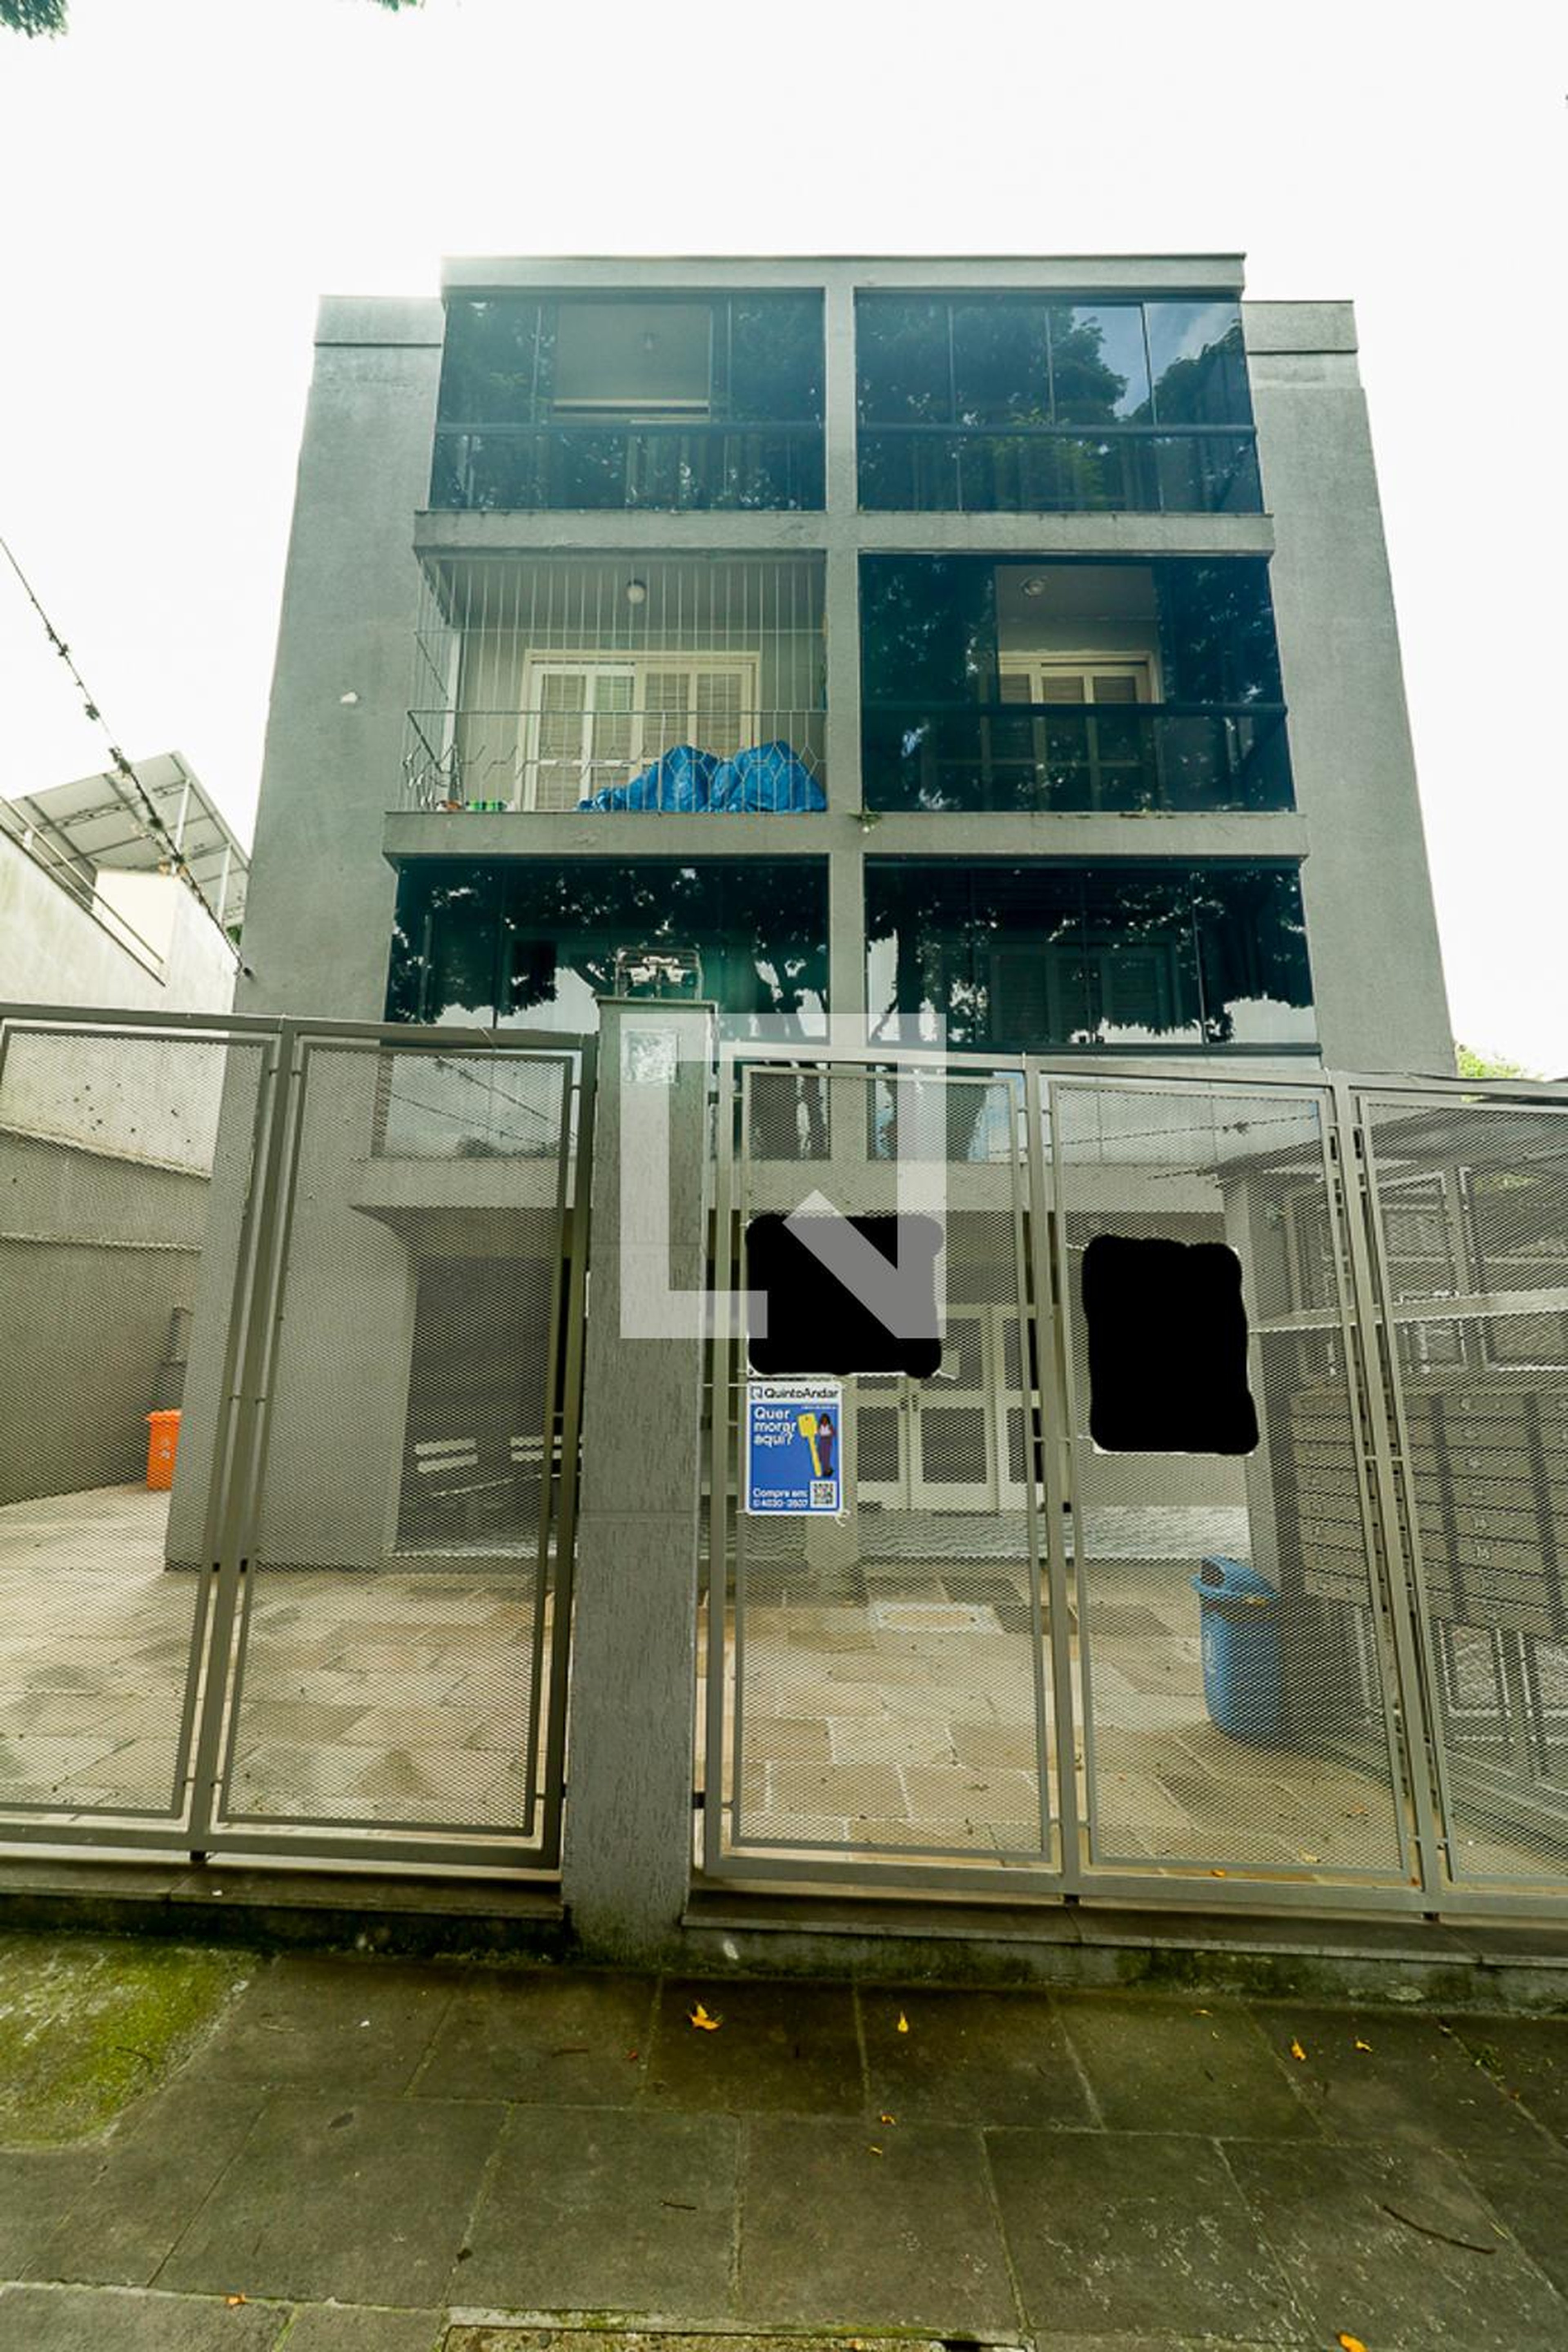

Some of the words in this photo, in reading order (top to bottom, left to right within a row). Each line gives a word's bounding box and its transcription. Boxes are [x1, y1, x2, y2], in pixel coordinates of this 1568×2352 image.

[764, 1388, 838, 1398] QuintoAndar
[754, 1407, 790, 1419] Quer
[754, 1422, 797, 1432] morar
[754, 1431, 793, 1447] aqui?
